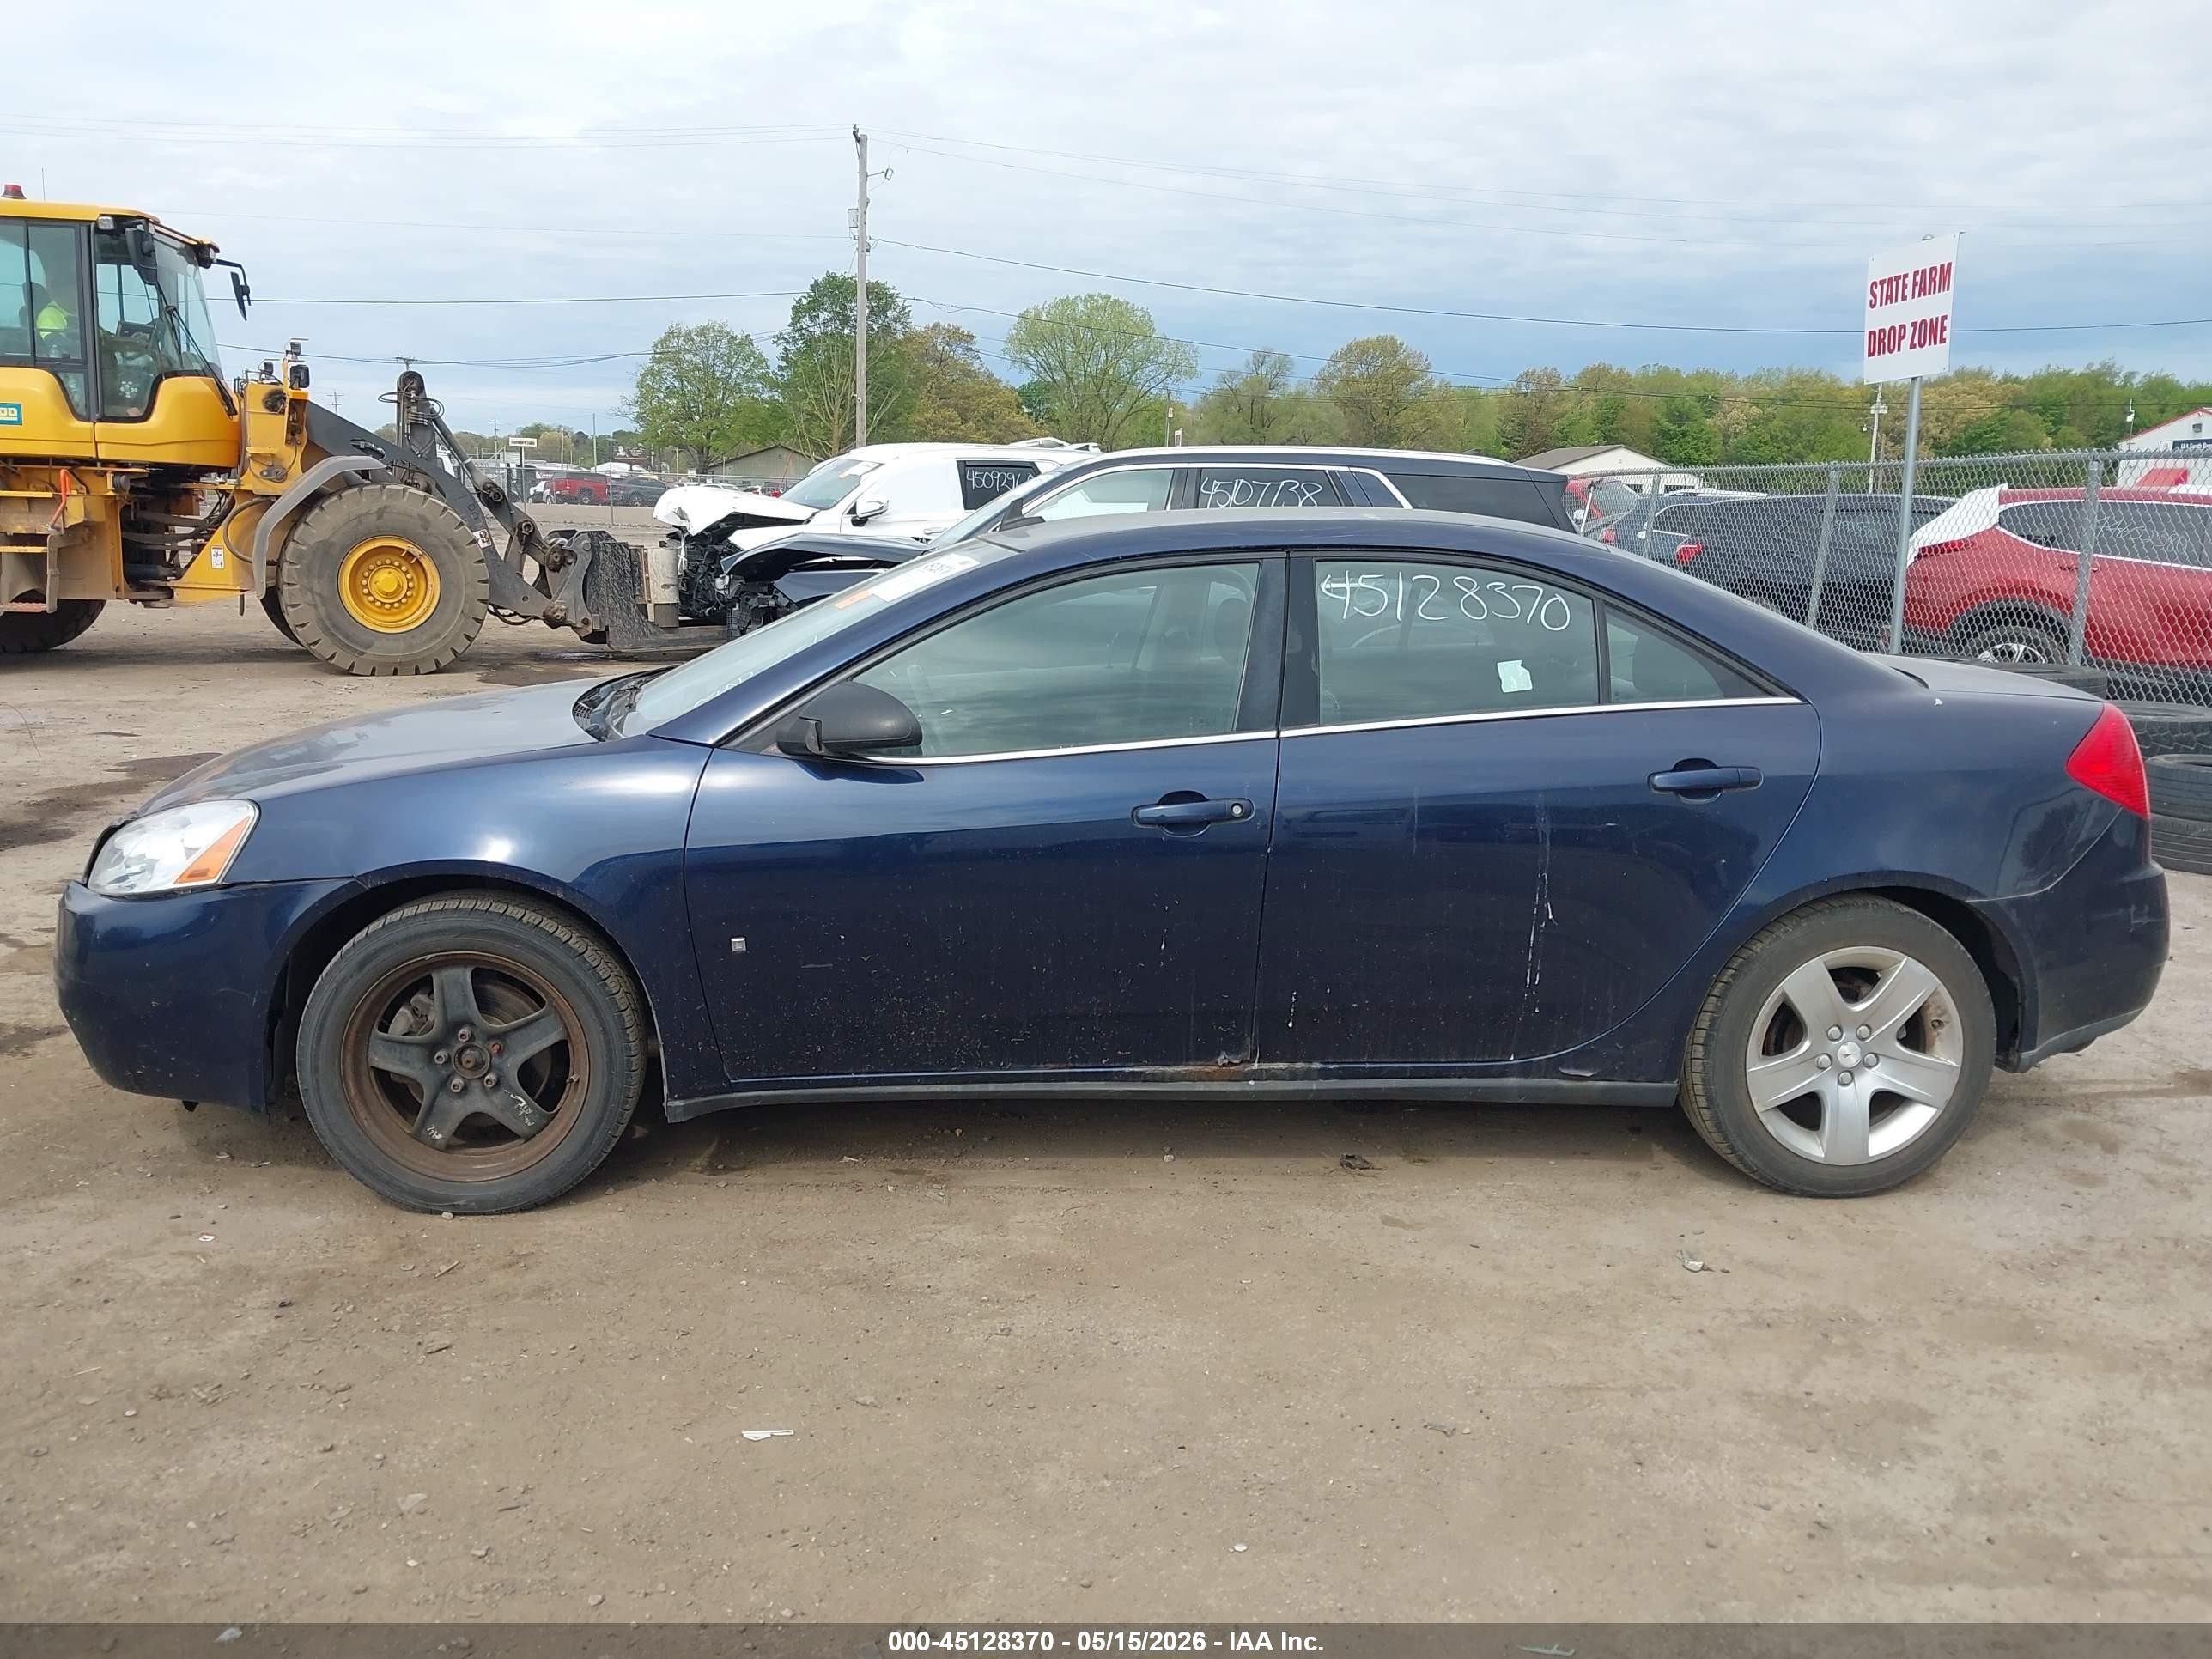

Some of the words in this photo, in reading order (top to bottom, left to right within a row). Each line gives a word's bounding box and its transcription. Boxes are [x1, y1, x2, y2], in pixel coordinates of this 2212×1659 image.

[1869, 272, 1909, 309] STATE
[1911, 261, 1953, 300] FARM
[1867, 323, 1906, 358] DROP
[1909, 314, 1948, 349] ZONE
[1320, 570, 1571, 631] 45128370
